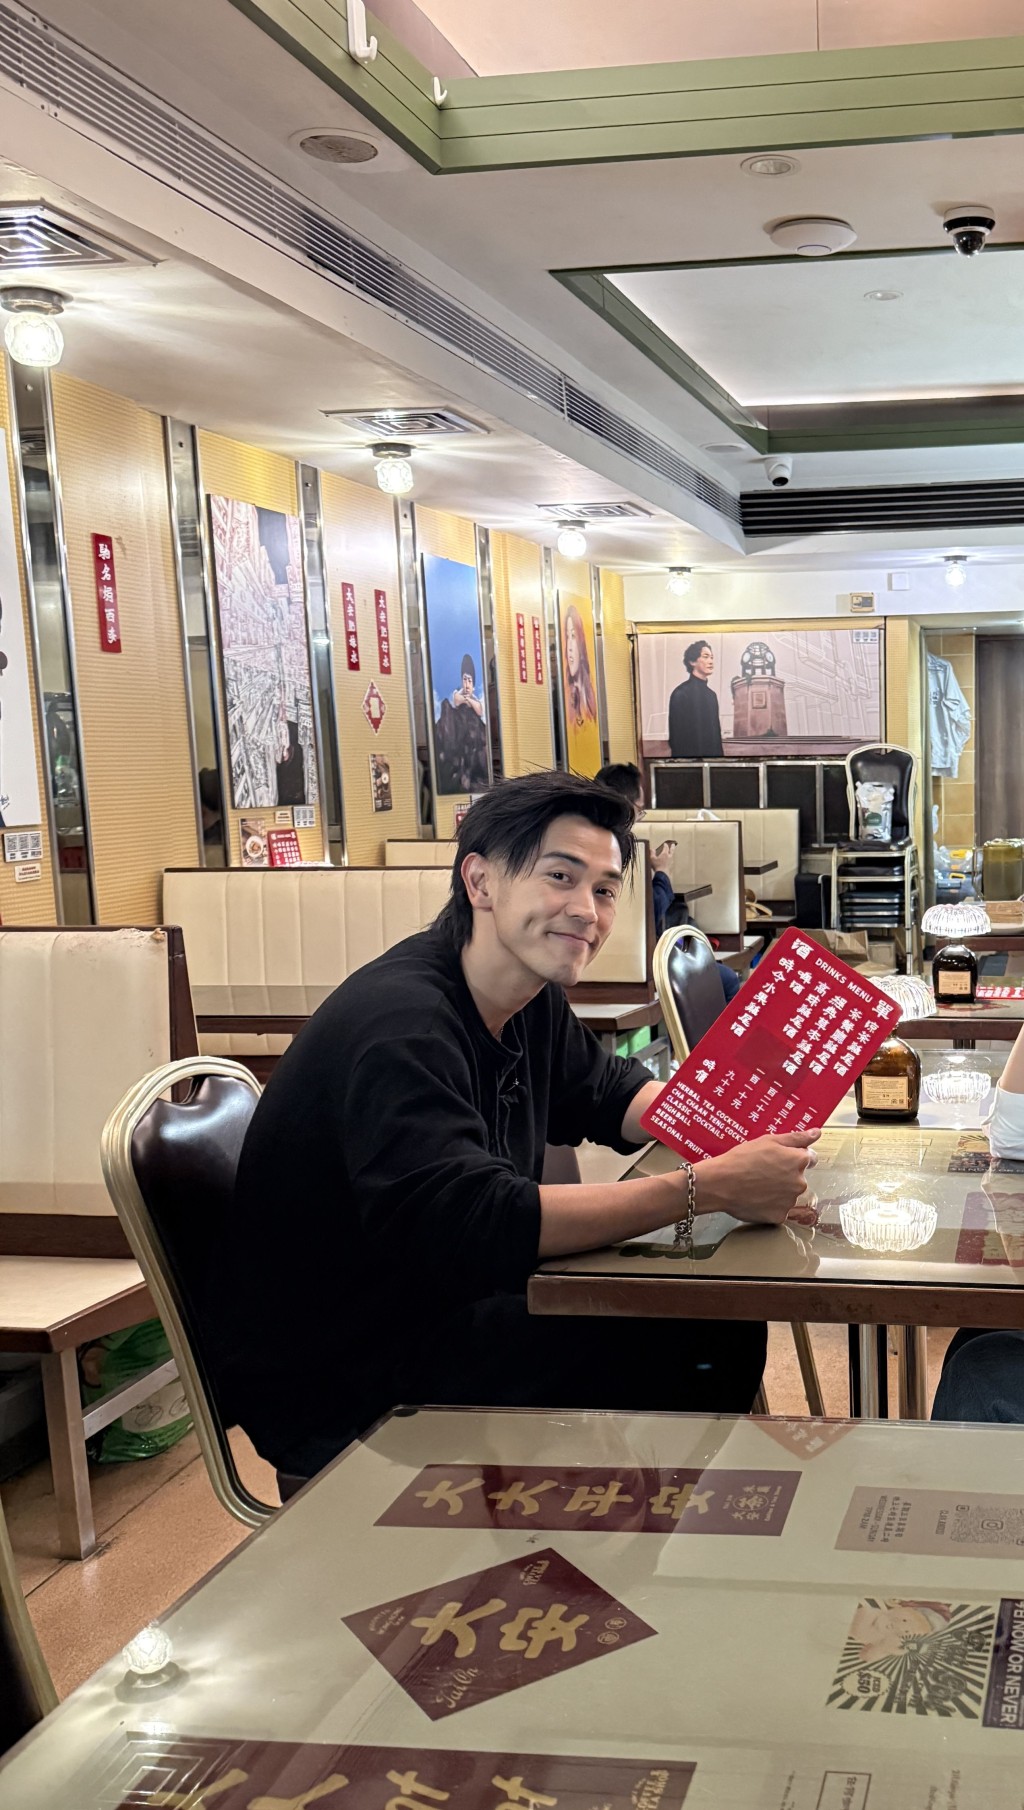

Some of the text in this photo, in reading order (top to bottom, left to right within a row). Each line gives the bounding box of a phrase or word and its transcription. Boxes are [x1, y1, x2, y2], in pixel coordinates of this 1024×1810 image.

[791, 938, 814, 960] 酒
[789, 970, 813, 995] 啤酒
[815, 957, 873, 1003] DRINKS MENU
[872, 999, 894, 1020] 單
[713, 1069, 736, 1097] 九十元
[730, 1067, 766, 1110] 一百一十元
[655, 1107, 677, 1126] BEERS
[660, 1101, 692, 1127] HIGHBALL
[666, 1094, 725, 1140] CLASSIC COCKTAILS
[671, 1088, 748, 1143] CHA CHAAN TENG COCKT
[676, 1081, 749, 1137] HERBAL TEA COCKTAILS
[748, 1080, 783, 1123] 一百二十元
[766, 1093, 800, 1135] 一百三十元
[650, 1114, 683, 1142] SEASONAL
[684, 1139, 704, 1156] FRUIT
[791, 1106, 818, 1133] 一百三
[410, 1598, 590, 1659] 大安
[1009, 1620, 1024, 1653] NOW
[1006, 1653, 1024, 1673] OR
[857, 1671, 872, 1694] $50
